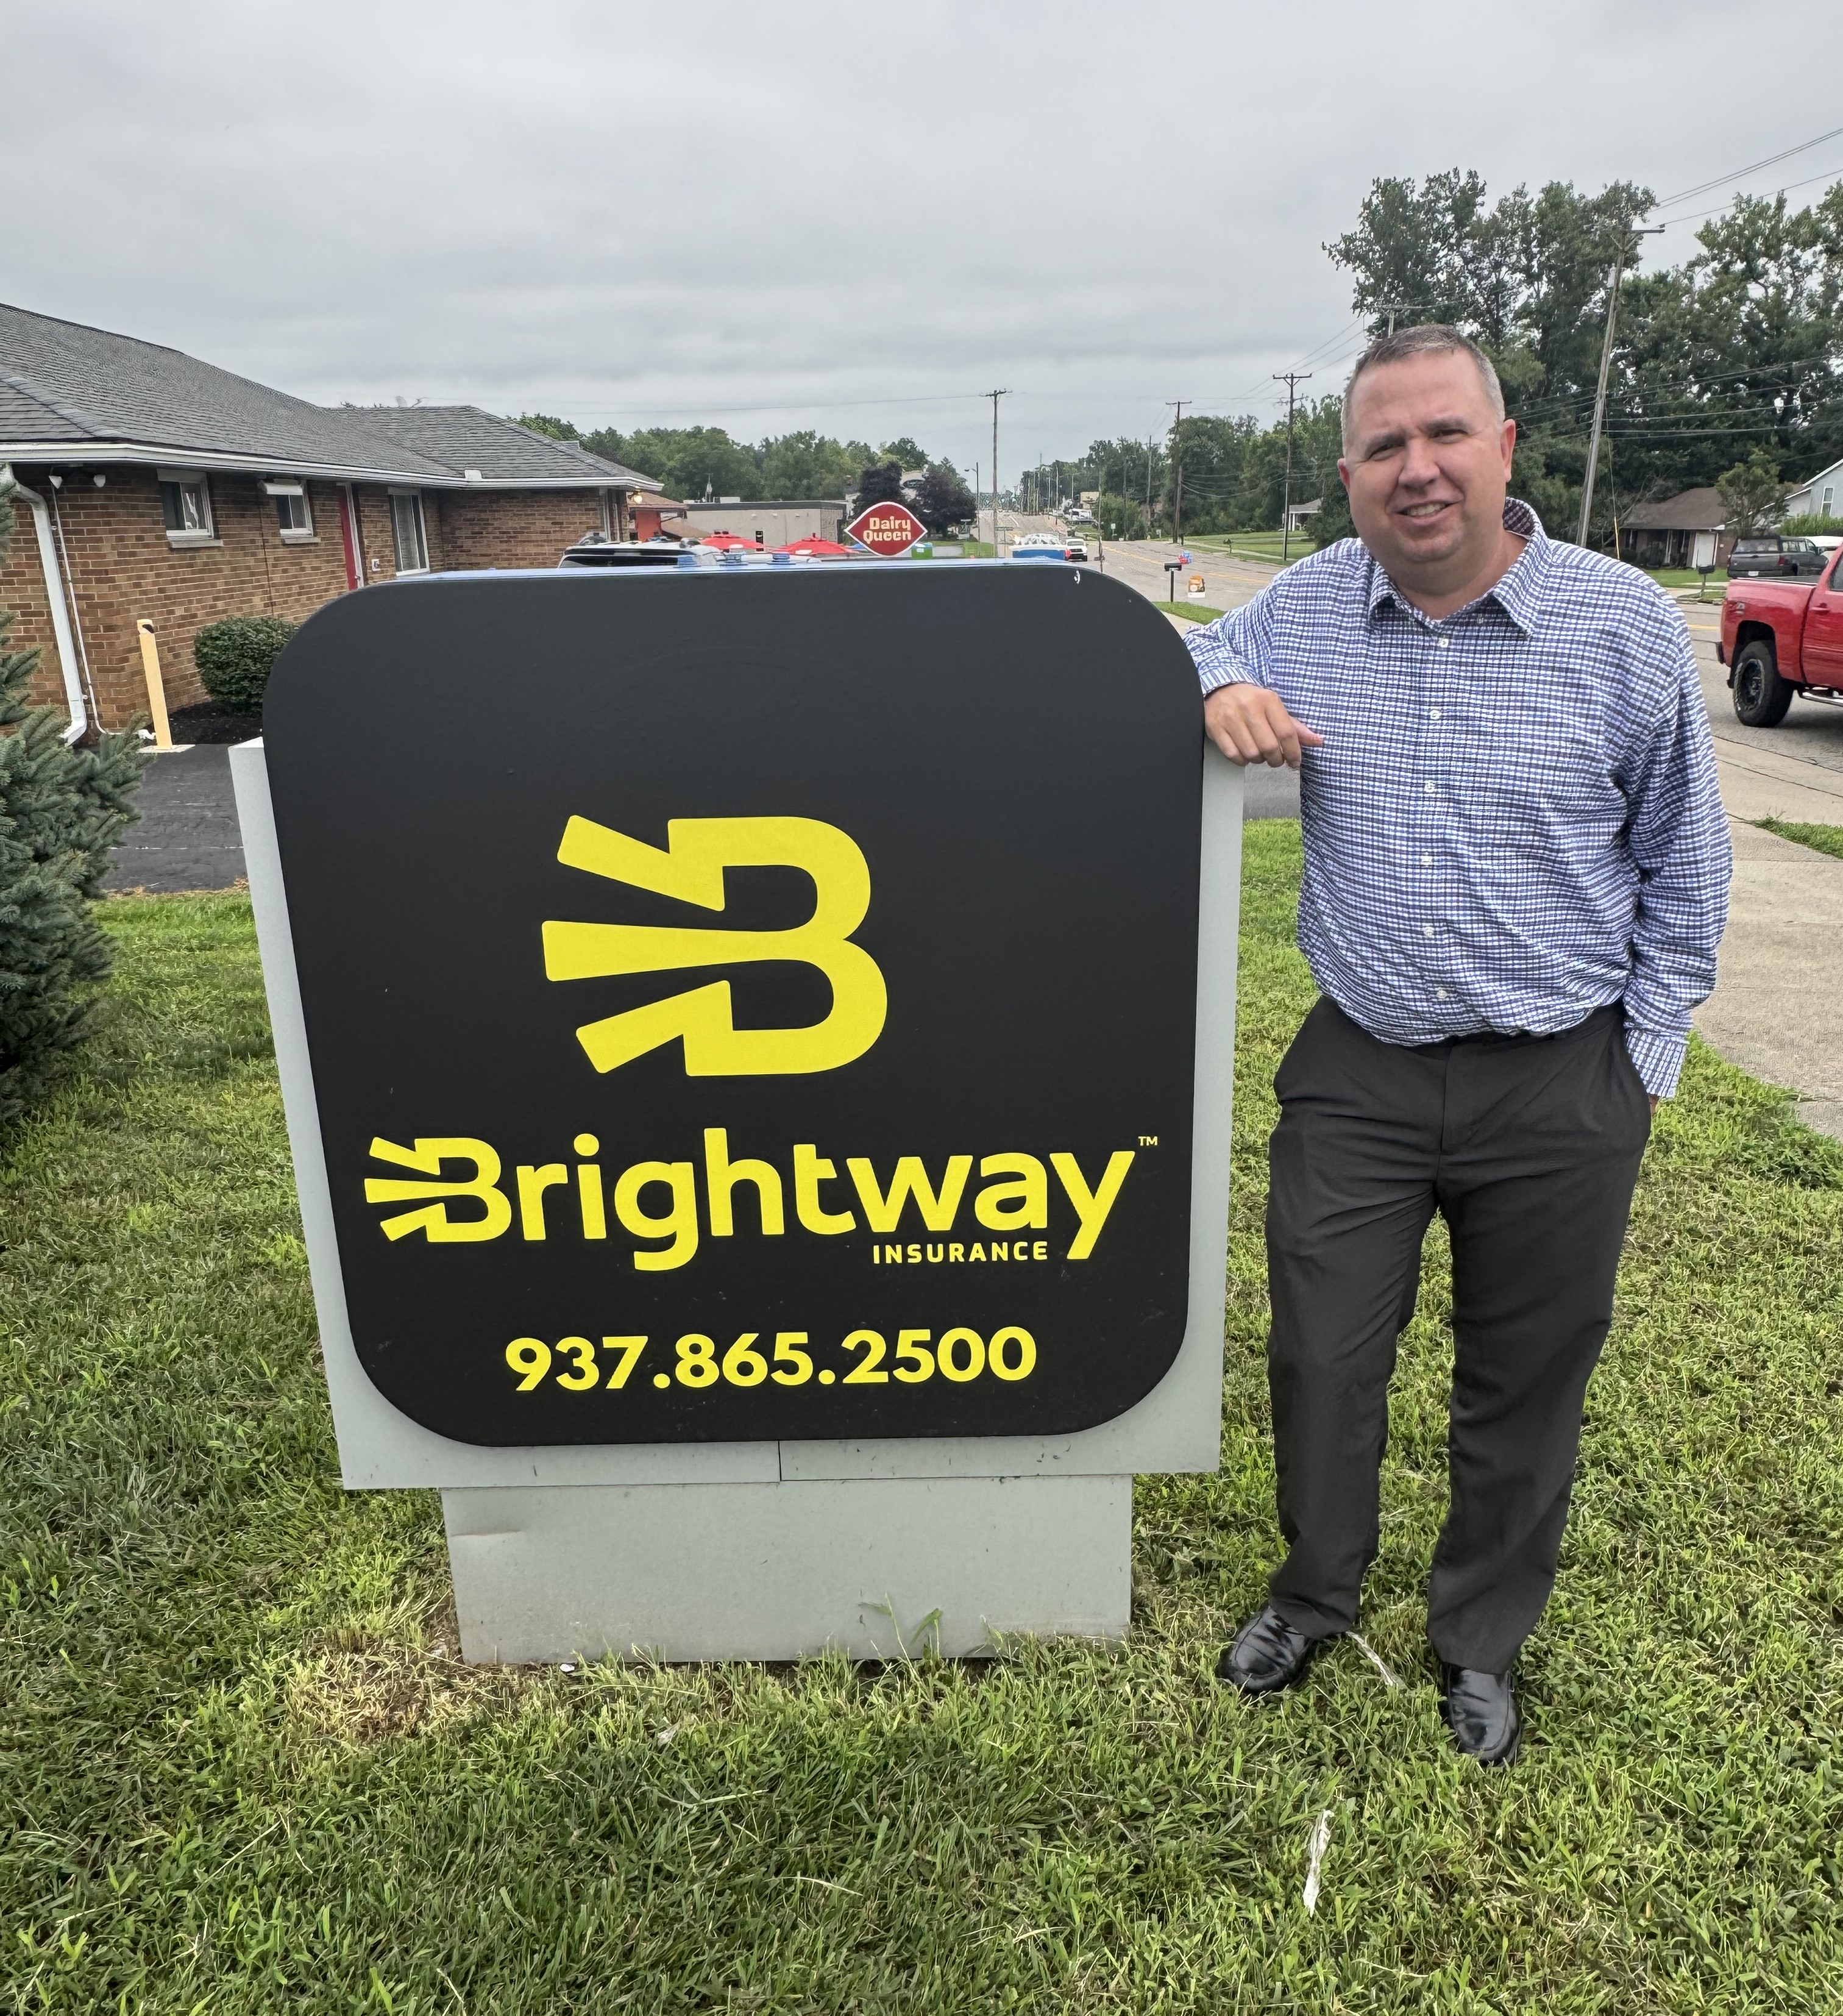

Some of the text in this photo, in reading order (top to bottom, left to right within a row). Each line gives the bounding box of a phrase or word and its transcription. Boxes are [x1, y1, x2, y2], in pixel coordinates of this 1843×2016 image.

[863, 530, 911, 544] Queen
[869, 516, 911, 530] Dairy
[541, 815, 888, 1077] B
[364, 1128, 1136, 1272] Brightway
[873, 1241, 1048, 1264] INSURANCE
[504, 1327, 1037, 1391] 937.865.2500
